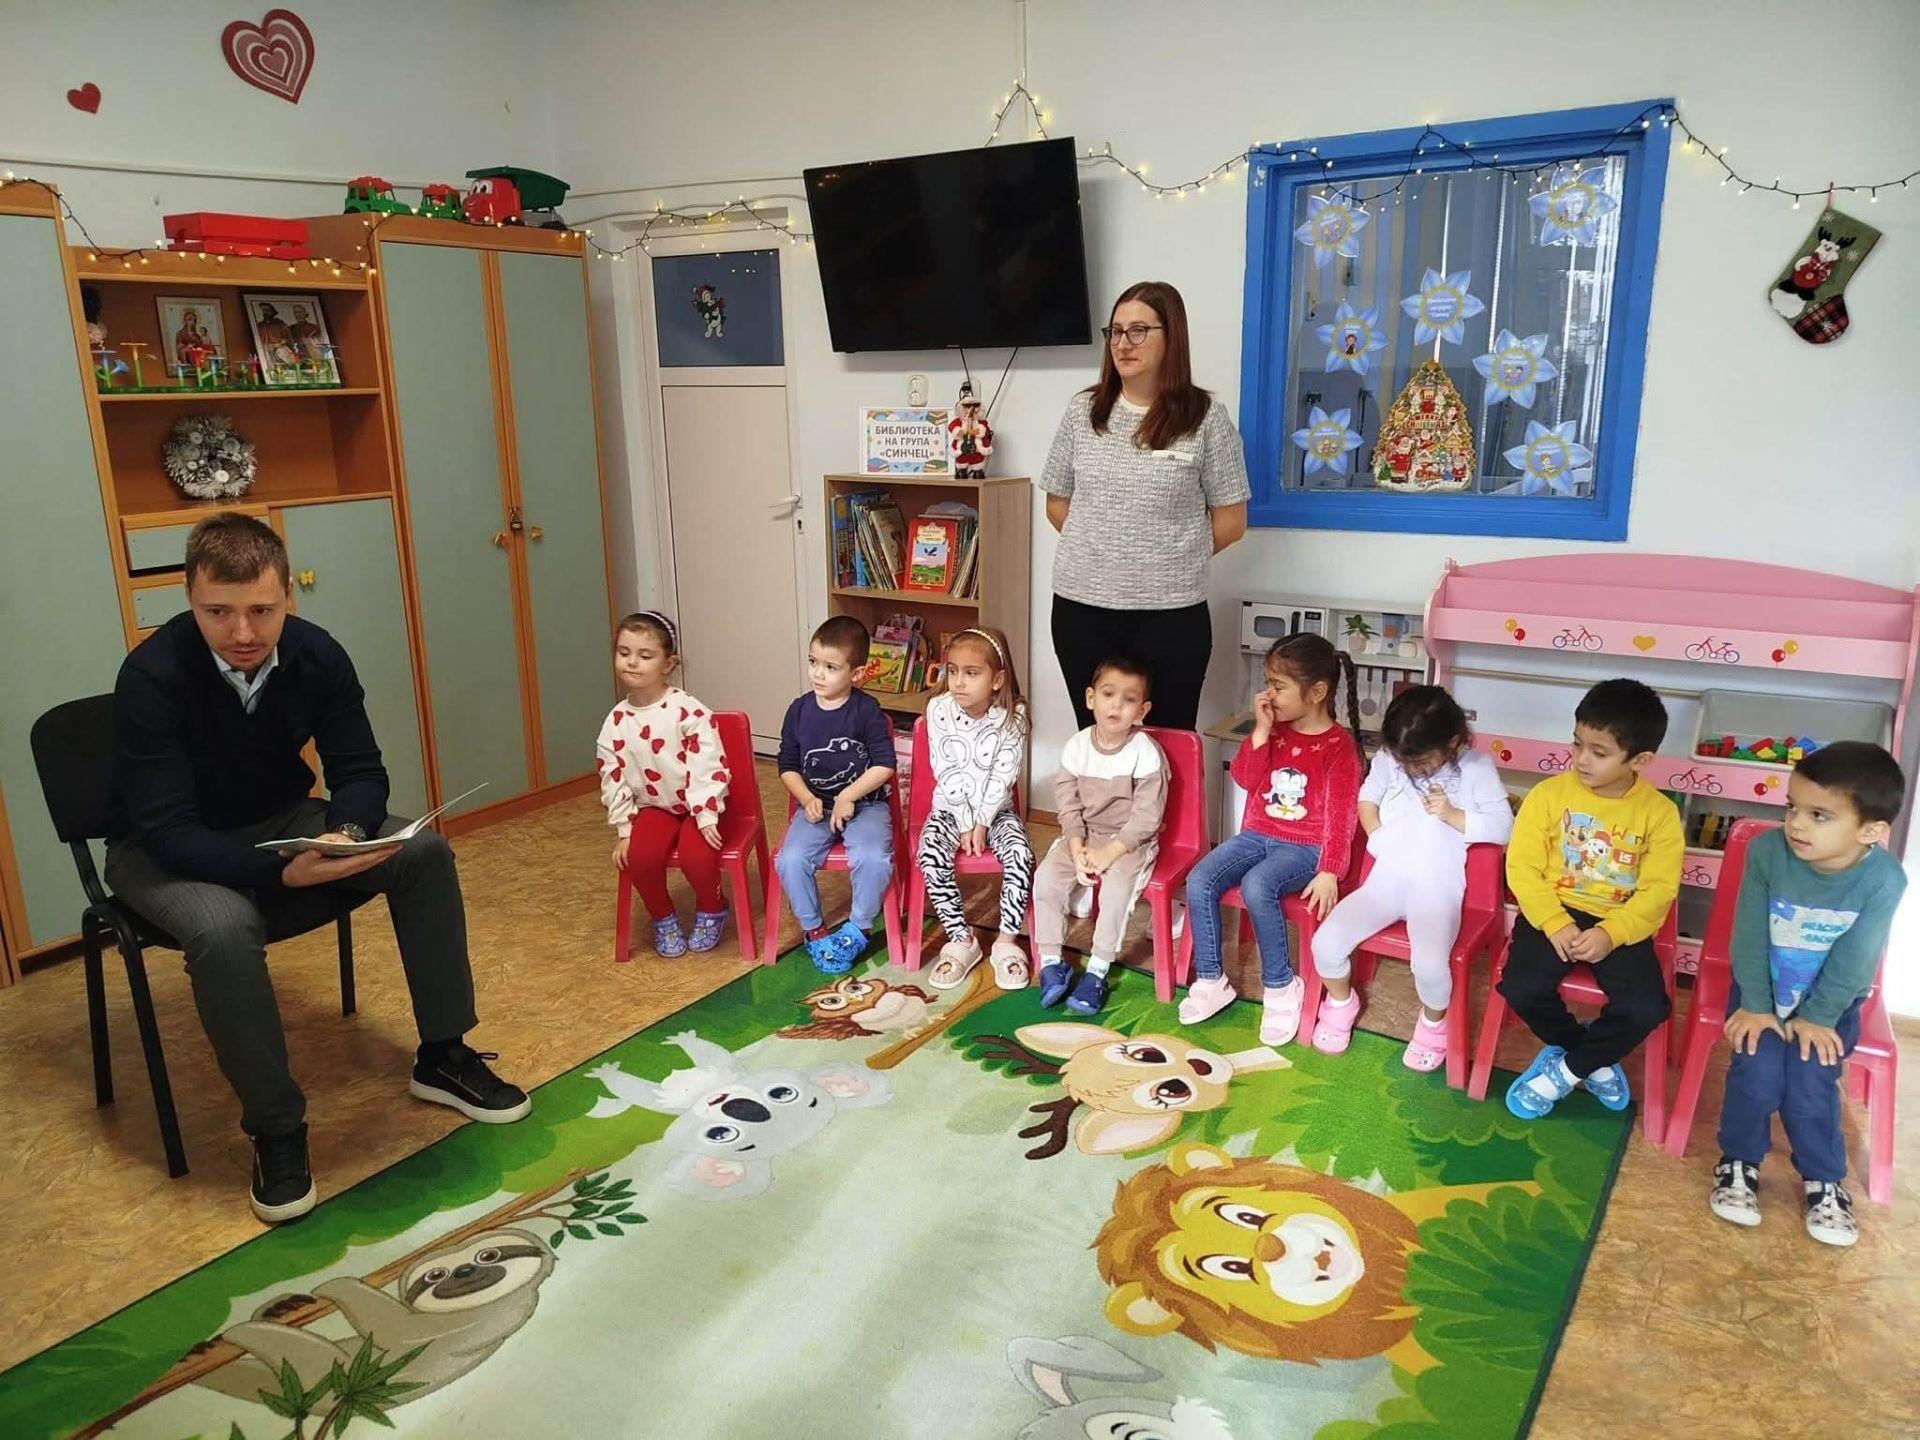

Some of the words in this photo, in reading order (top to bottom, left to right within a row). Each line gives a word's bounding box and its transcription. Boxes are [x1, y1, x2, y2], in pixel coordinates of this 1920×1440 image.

[875, 425, 941, 436] БИБЛИОТЕКА
[885, 437, 898, 446] НА
[900, 438, 930, 446] ГРУПА
